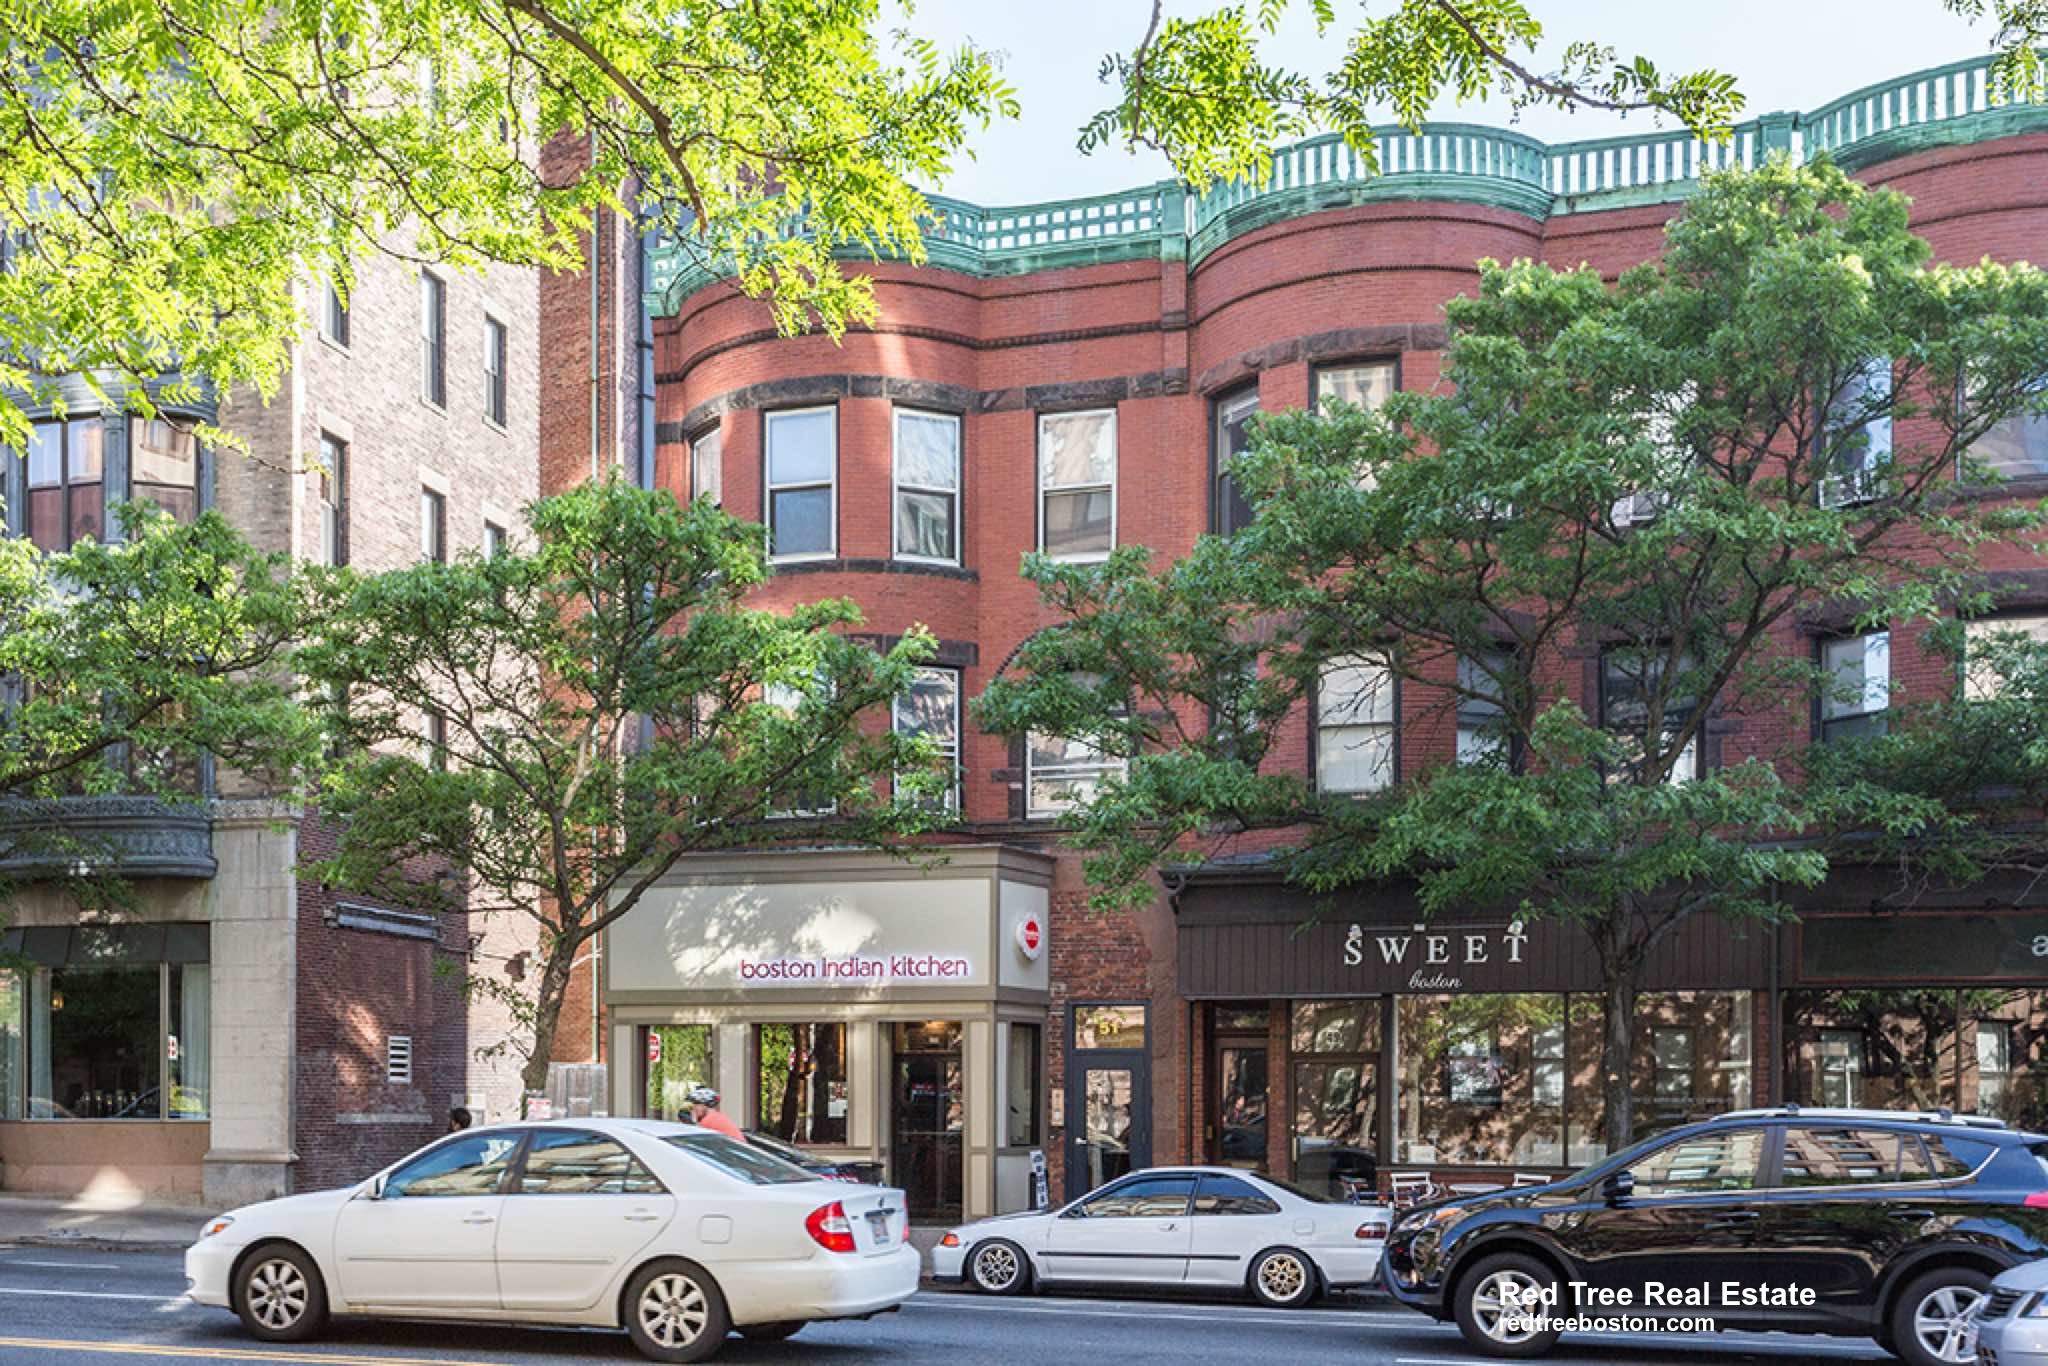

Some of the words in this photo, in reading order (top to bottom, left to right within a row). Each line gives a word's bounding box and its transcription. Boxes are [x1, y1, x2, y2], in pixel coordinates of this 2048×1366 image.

[1343, 935, 1529, 965] SWEET
[738, 959, 816, 978] boston
[889, 955, 970, 977] kitchen
[1407, 969, 1463, 989] boston
[1099, 1021, 1119, 1036] 51
